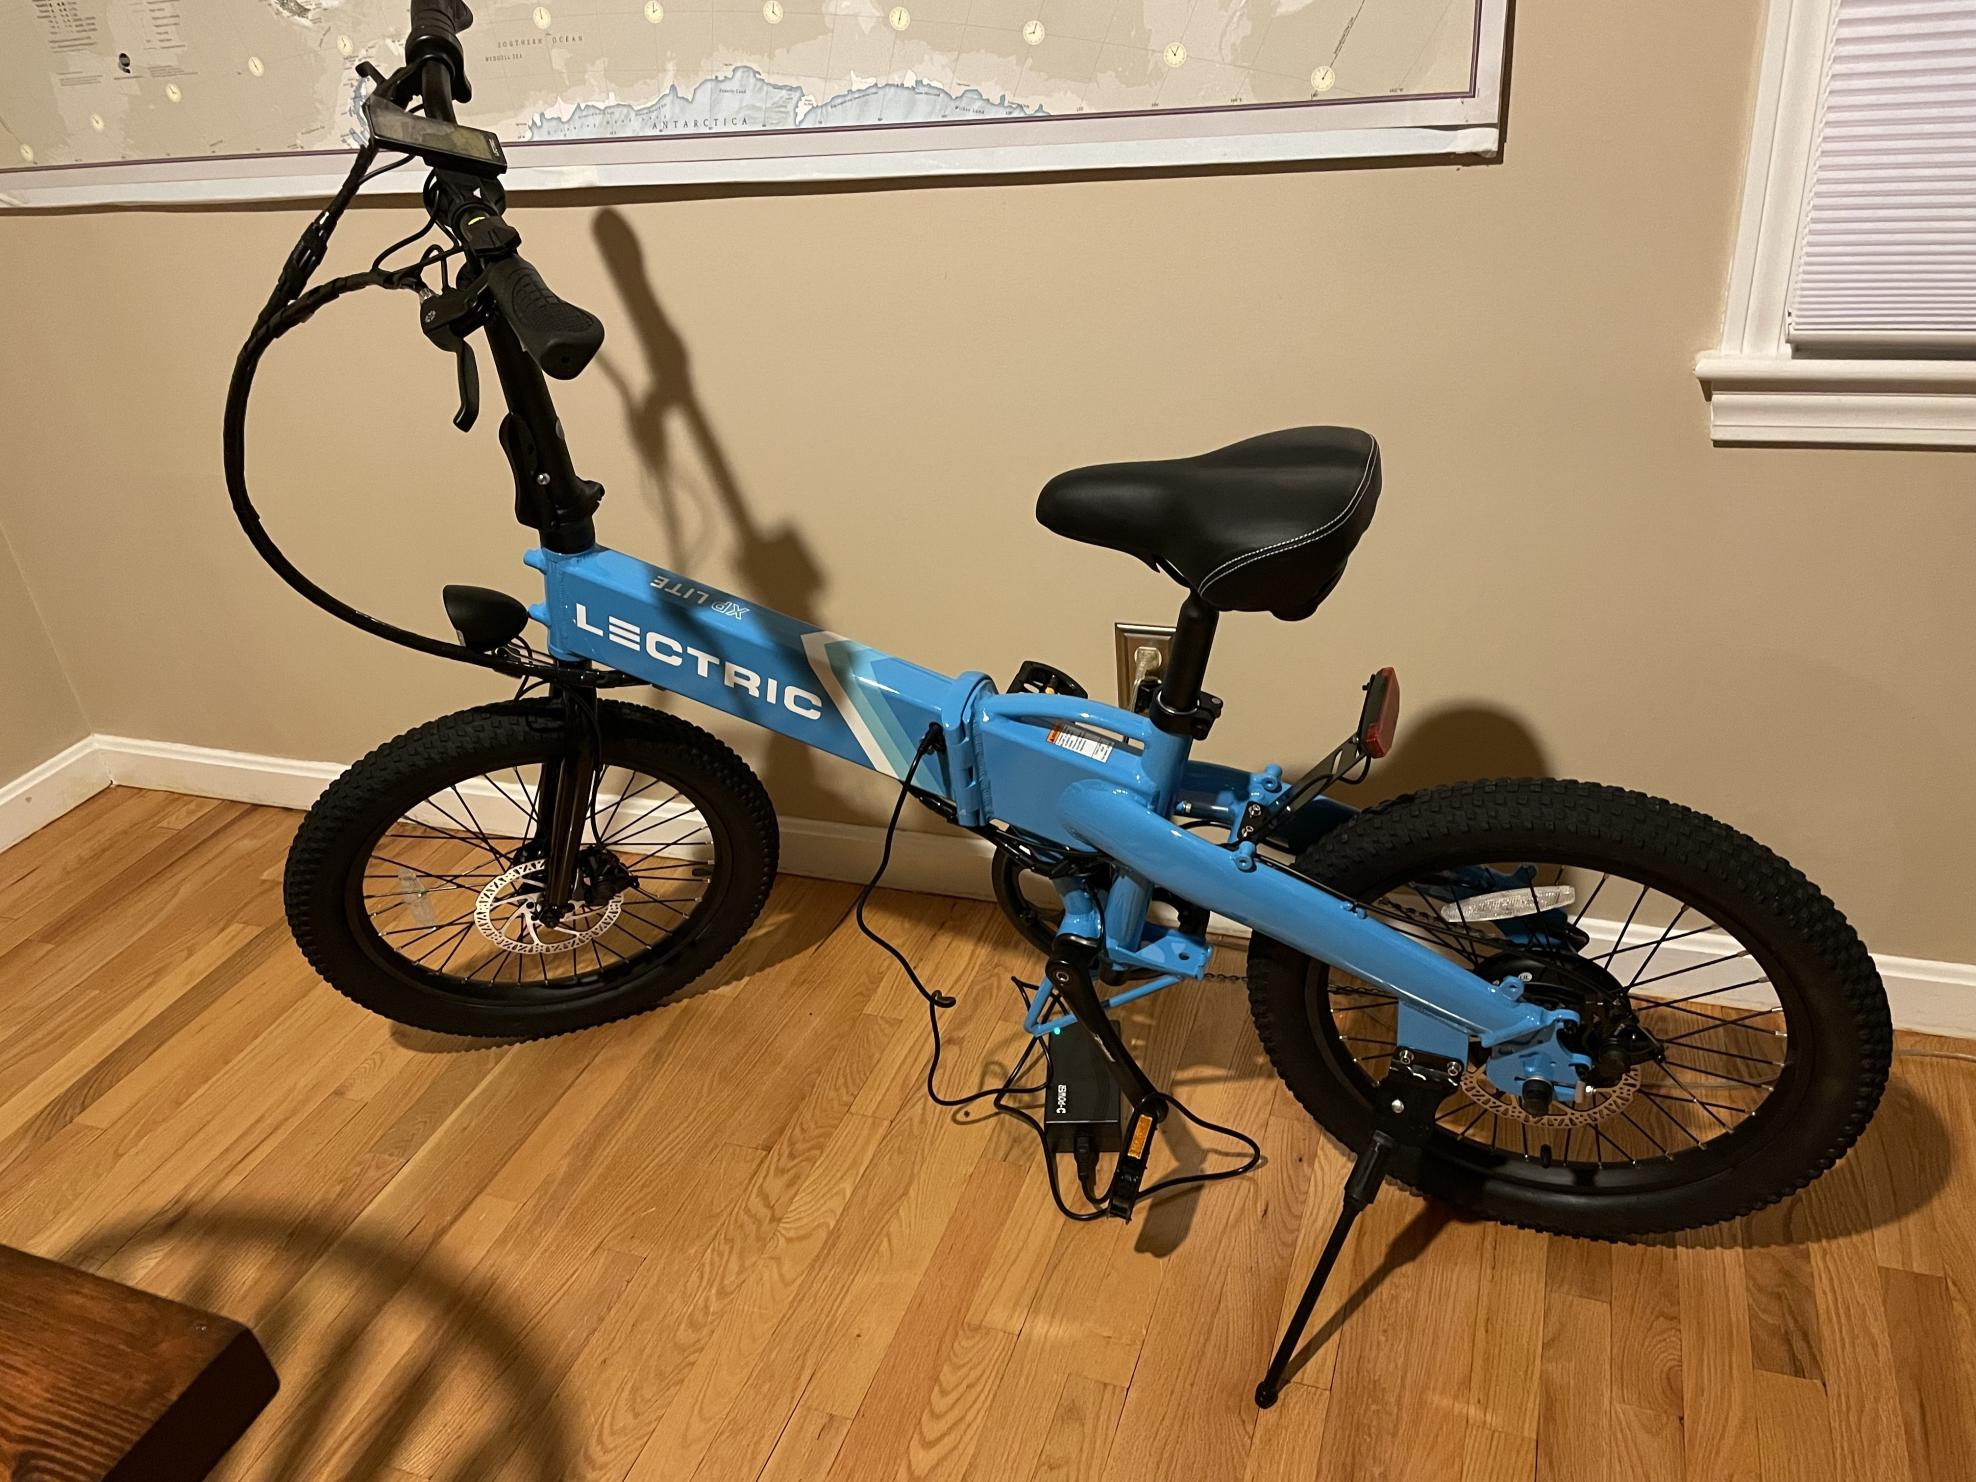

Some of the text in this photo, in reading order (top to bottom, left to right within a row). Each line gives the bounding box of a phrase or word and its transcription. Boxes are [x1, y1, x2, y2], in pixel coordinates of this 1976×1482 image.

[652, 116, 749, 130] ANTARCTICA
[650, 576, 750, 620] XP LITE
[576, 603, 822, 720] LECTRIC
